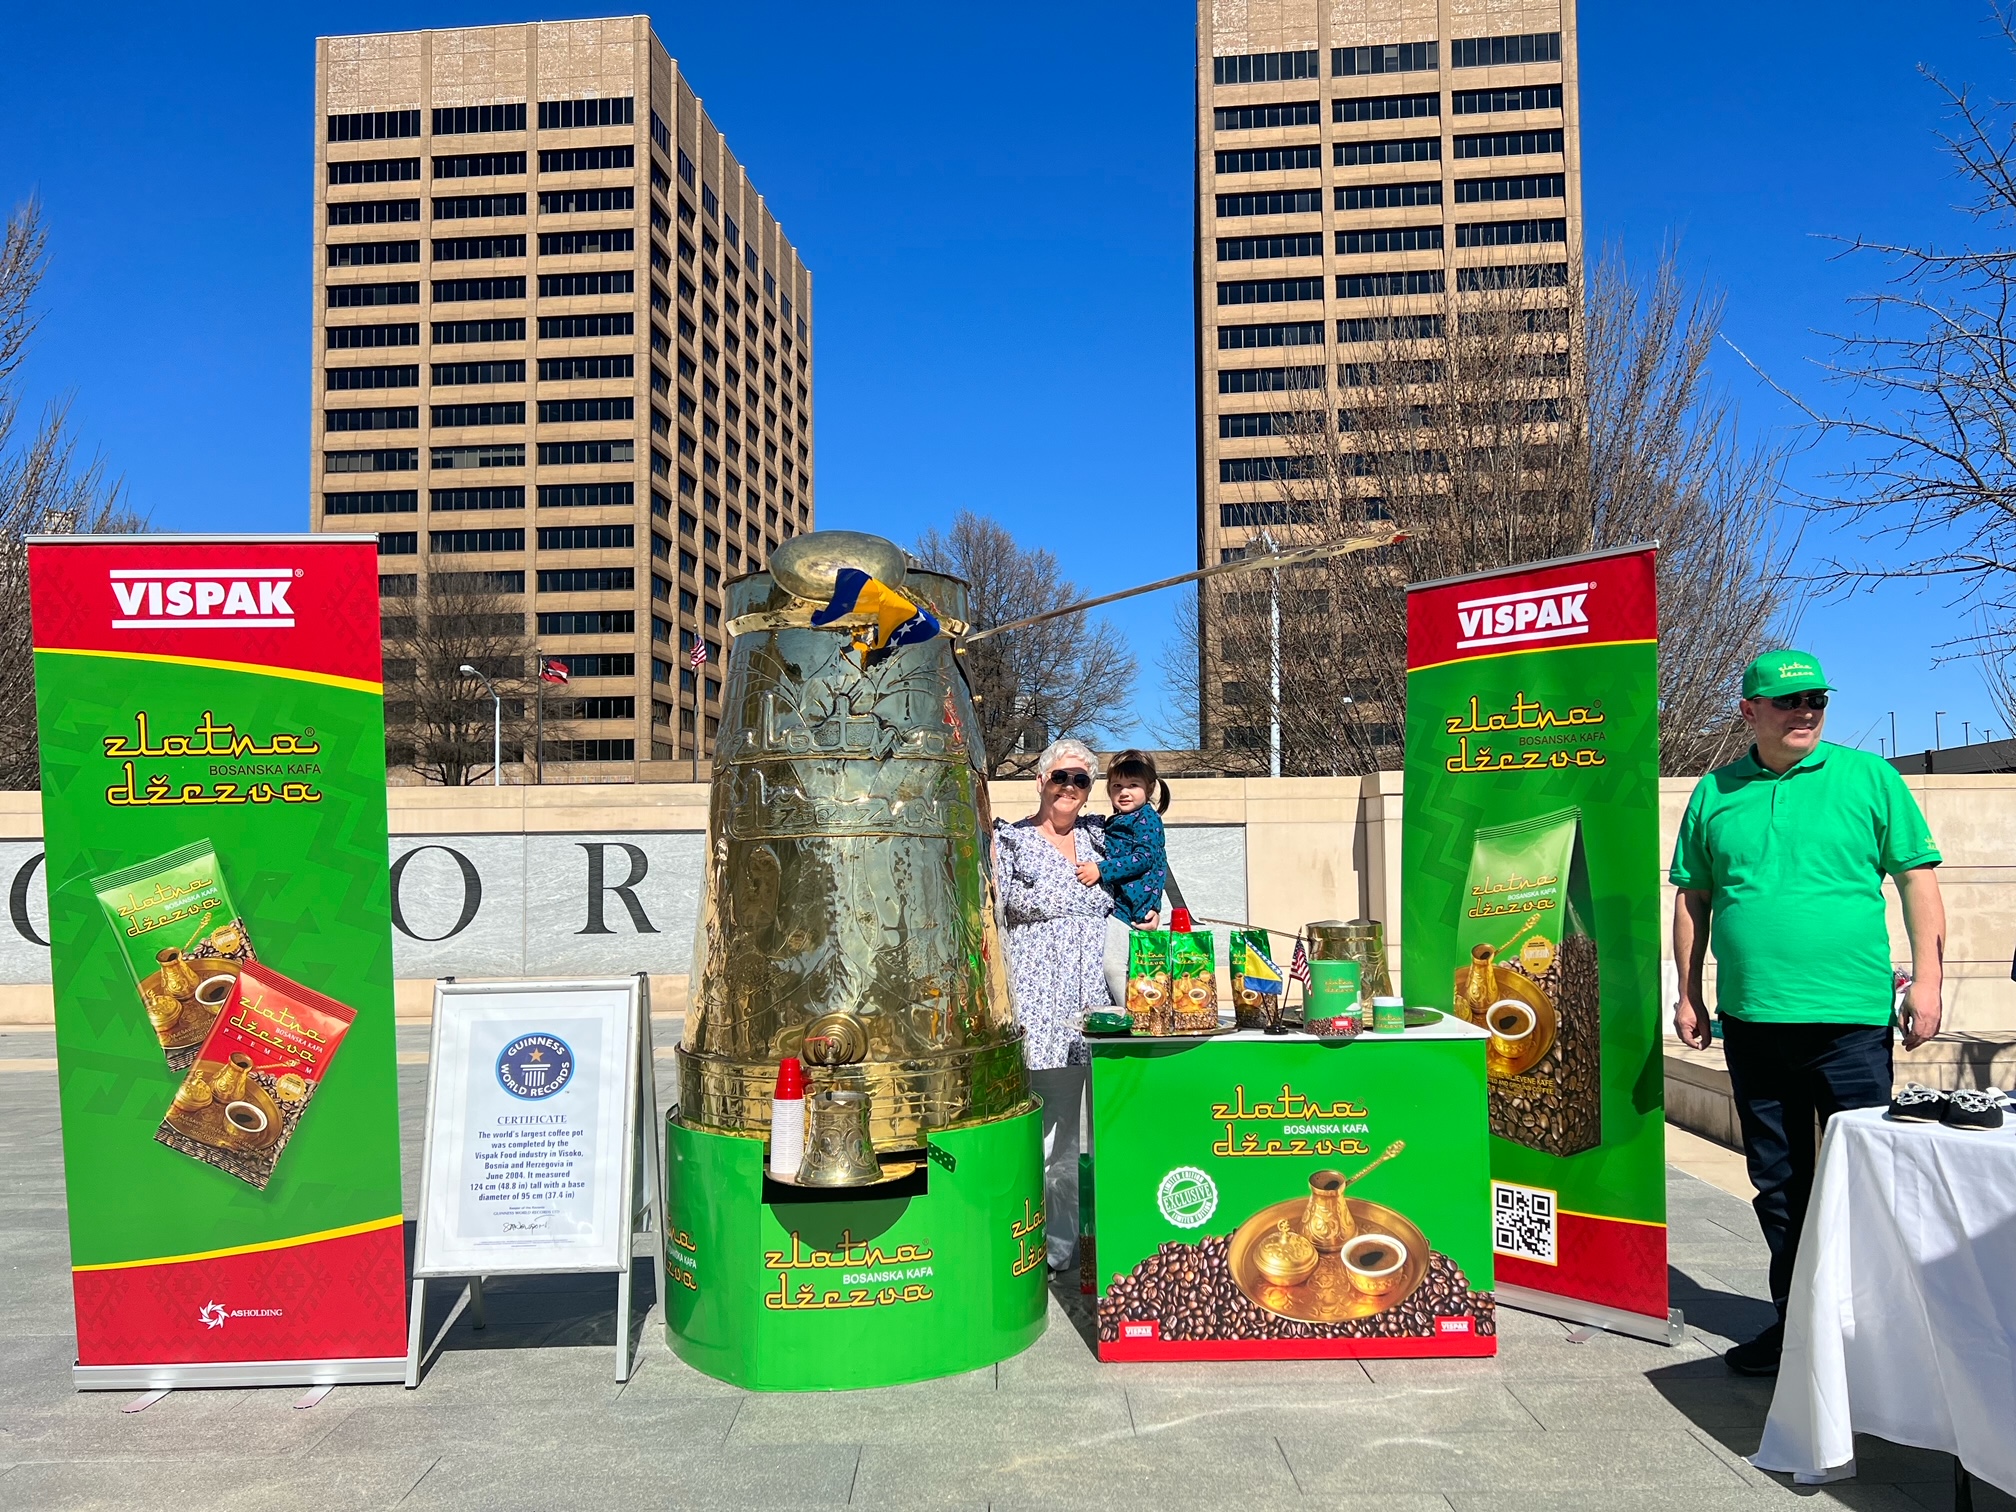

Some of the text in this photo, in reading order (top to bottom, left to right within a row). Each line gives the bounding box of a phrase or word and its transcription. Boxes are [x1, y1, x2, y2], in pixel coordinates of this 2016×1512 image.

[110, 581, 295, 616] VISPAK
[1457, 594, 1588, 638] VISPAK
[1446, 691, 1605, 733] zlatna
[103, 710, 320, 759] zlatna
[1519, 732, 1606, 746] BOSANSKA KAFA
[1446, 736, 1606, 772] džezva
[106, 760, 322, 806] džezva
[209, 764, 321, 776] BOSANSKA KAFA
[1471, 872, 1557, 896] zlatna
[1507, 891, 1540, 901] BOSANSKA
[117, 878, 212, 917] zlatna
[165, 887, 218, 911] BOSANSKA KAFA
[1468, 897, 1556, 918] džezva
[126, 898, 222, 937] džezva
[239, 995, 326, 1044] zlatna
[229, 1010, 317, 1064] džezva
[275, 1027, 324, 1054] BOSANSKA KAFA
[507, 1037, 565, 1056] GUINNESS
[501, 1061, 570, 1097] WORLD RECORDS
[1211, 1084, 1369, 1121] zlatna
[497, 1115, 567, 1125] CERTIFICATE
[1284, 1124, 1369, 1135] BOSANSKA KAFA
[508, 1140, 545, 1149] completed
[547, 1140, 555, 1148] by
[521, 1131, 546, 1139] largest
[1212, 1122, 1370, 1157] džezva
[475, 1152, 498, 1160] Vispak
[519, 1151, 547, 1159] industry
[535, 1170, 570, 1178] measured
[479, 1193, 510, 1201] diameter
[1163, 1184, 1212, 1210] EXCLUSIVE
[764, 1228, 934, 1270] zlatna
[843, 1267, 934, 1285] BOSANSKA KAFA
[764, 1271, 934, 1311] džezva
